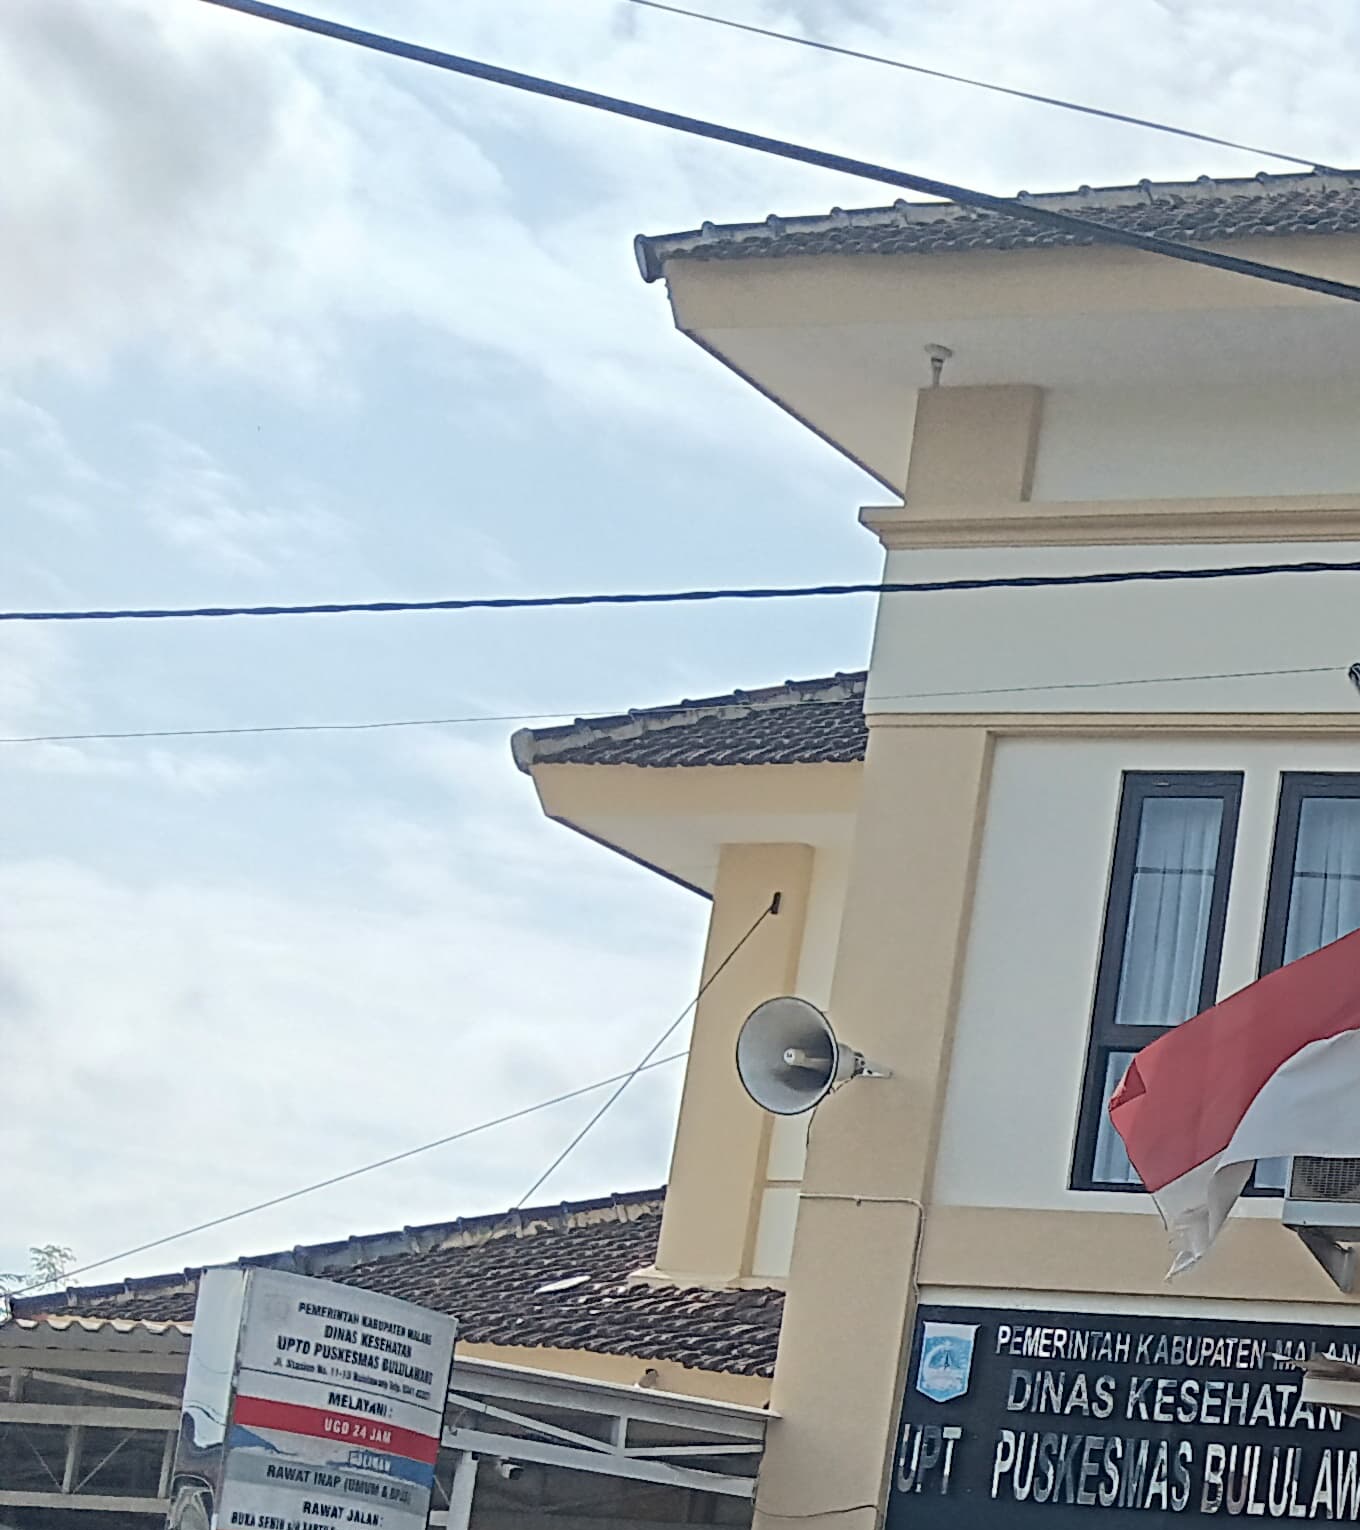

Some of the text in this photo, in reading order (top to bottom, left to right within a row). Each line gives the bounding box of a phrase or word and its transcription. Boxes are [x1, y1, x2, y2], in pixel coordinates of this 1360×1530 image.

[298, 1302, 359, 1324] PEMERINTAH
[362, 1313, 406, 1337] KABUPATEN
[277, 1335, 311, 1355] UPTD
[313, 1342, 380, 1370] PUSKESMAS
[324, 1325, 412, 1358] DINAS KESEHATAN
[995, 1325, 1130, 1364] PEMERINTAH
[1136, 1333, 1266, 1369] KABUPATEN
[1006, 1367, 1343, 1431] DINAS KESEHATAN
[324, 1418, 392, 1444] UGD 24 JAM
[267, 1464, 311, 1482] RAWAT
[313, 1472, 341, 1488] INAP
[897, 1424, 963, 1494] UPT
[991, 1429, 1193, 1514] PUSKESMAS
[231, 1511, 256, 1527] BUKA
[257, 1515, 285, 1530] SENIN
[302, 1501, 344, 1519] RAWAT
